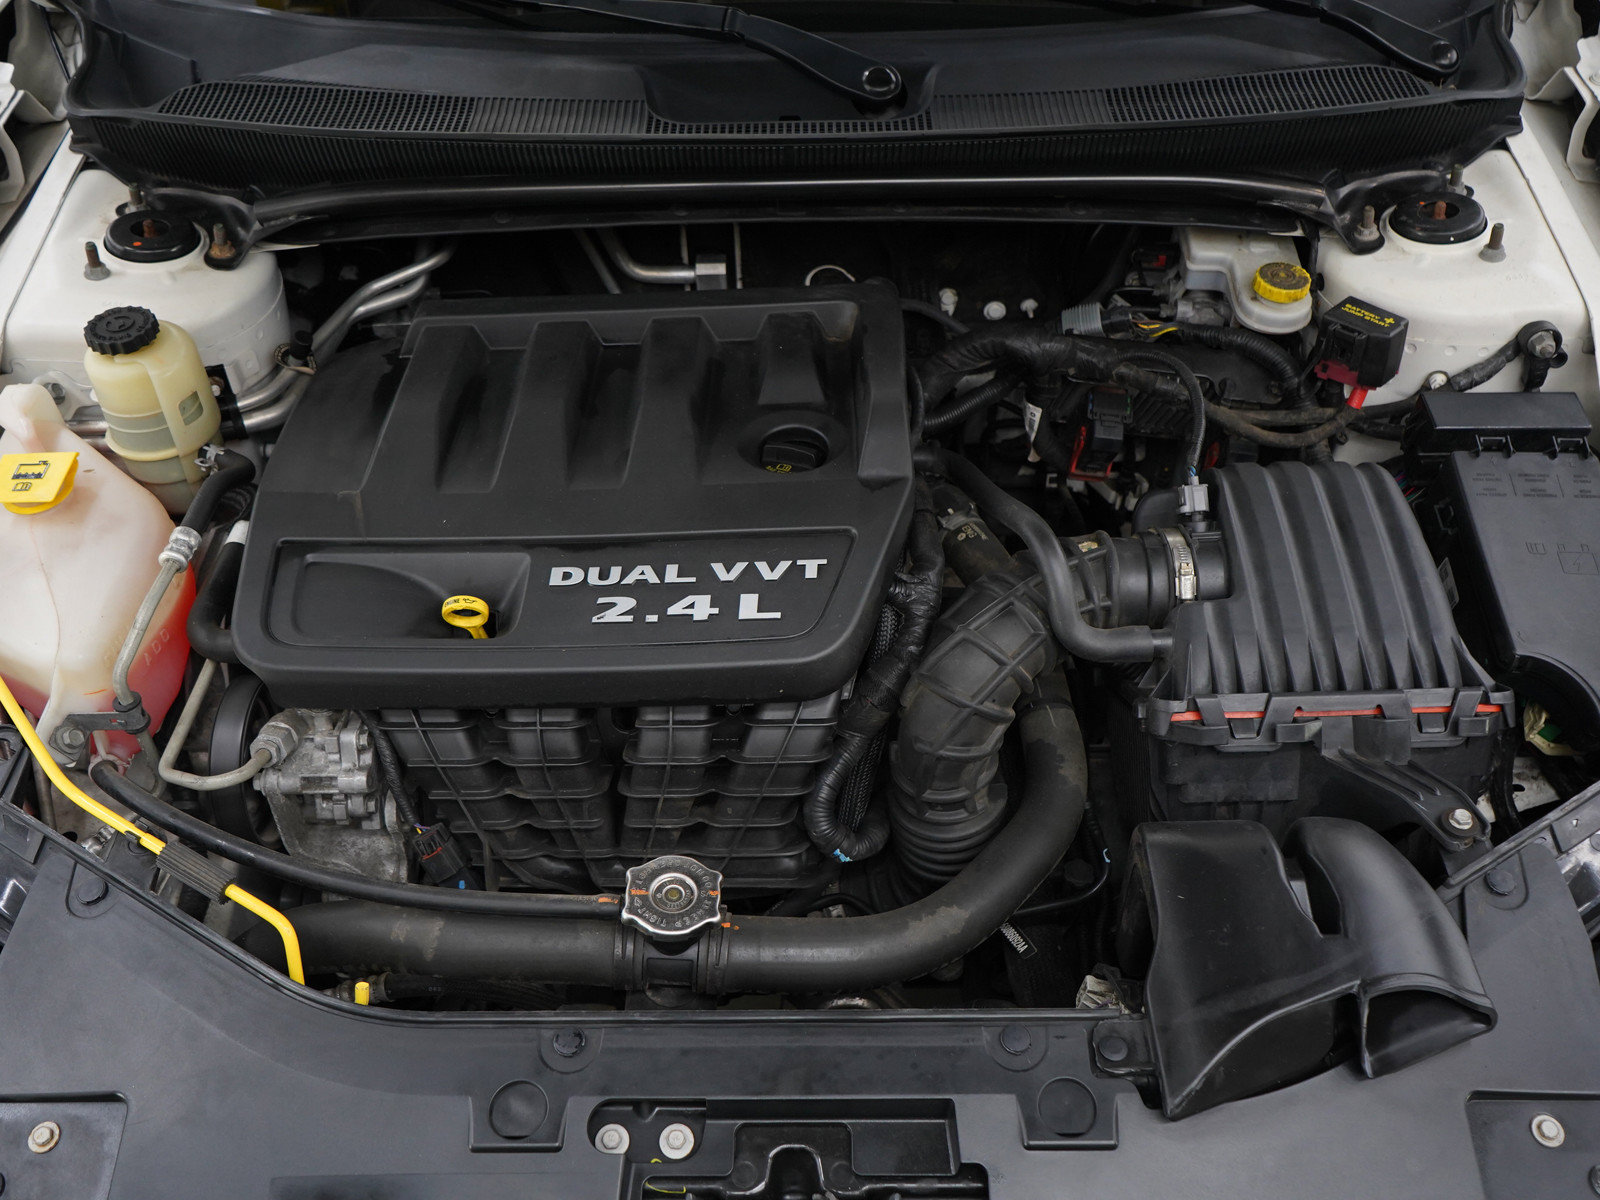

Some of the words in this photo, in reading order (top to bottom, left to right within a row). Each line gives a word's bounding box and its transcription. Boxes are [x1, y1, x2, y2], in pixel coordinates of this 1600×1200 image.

[1341, 306, 1364, 317] JUMP
[1364, 315, 1390, 328] START
[1345, 303, 1381, 320] BATTERY
[548, 563, 697, 586] DUAL
[710, 558, 828, 582] VVT
